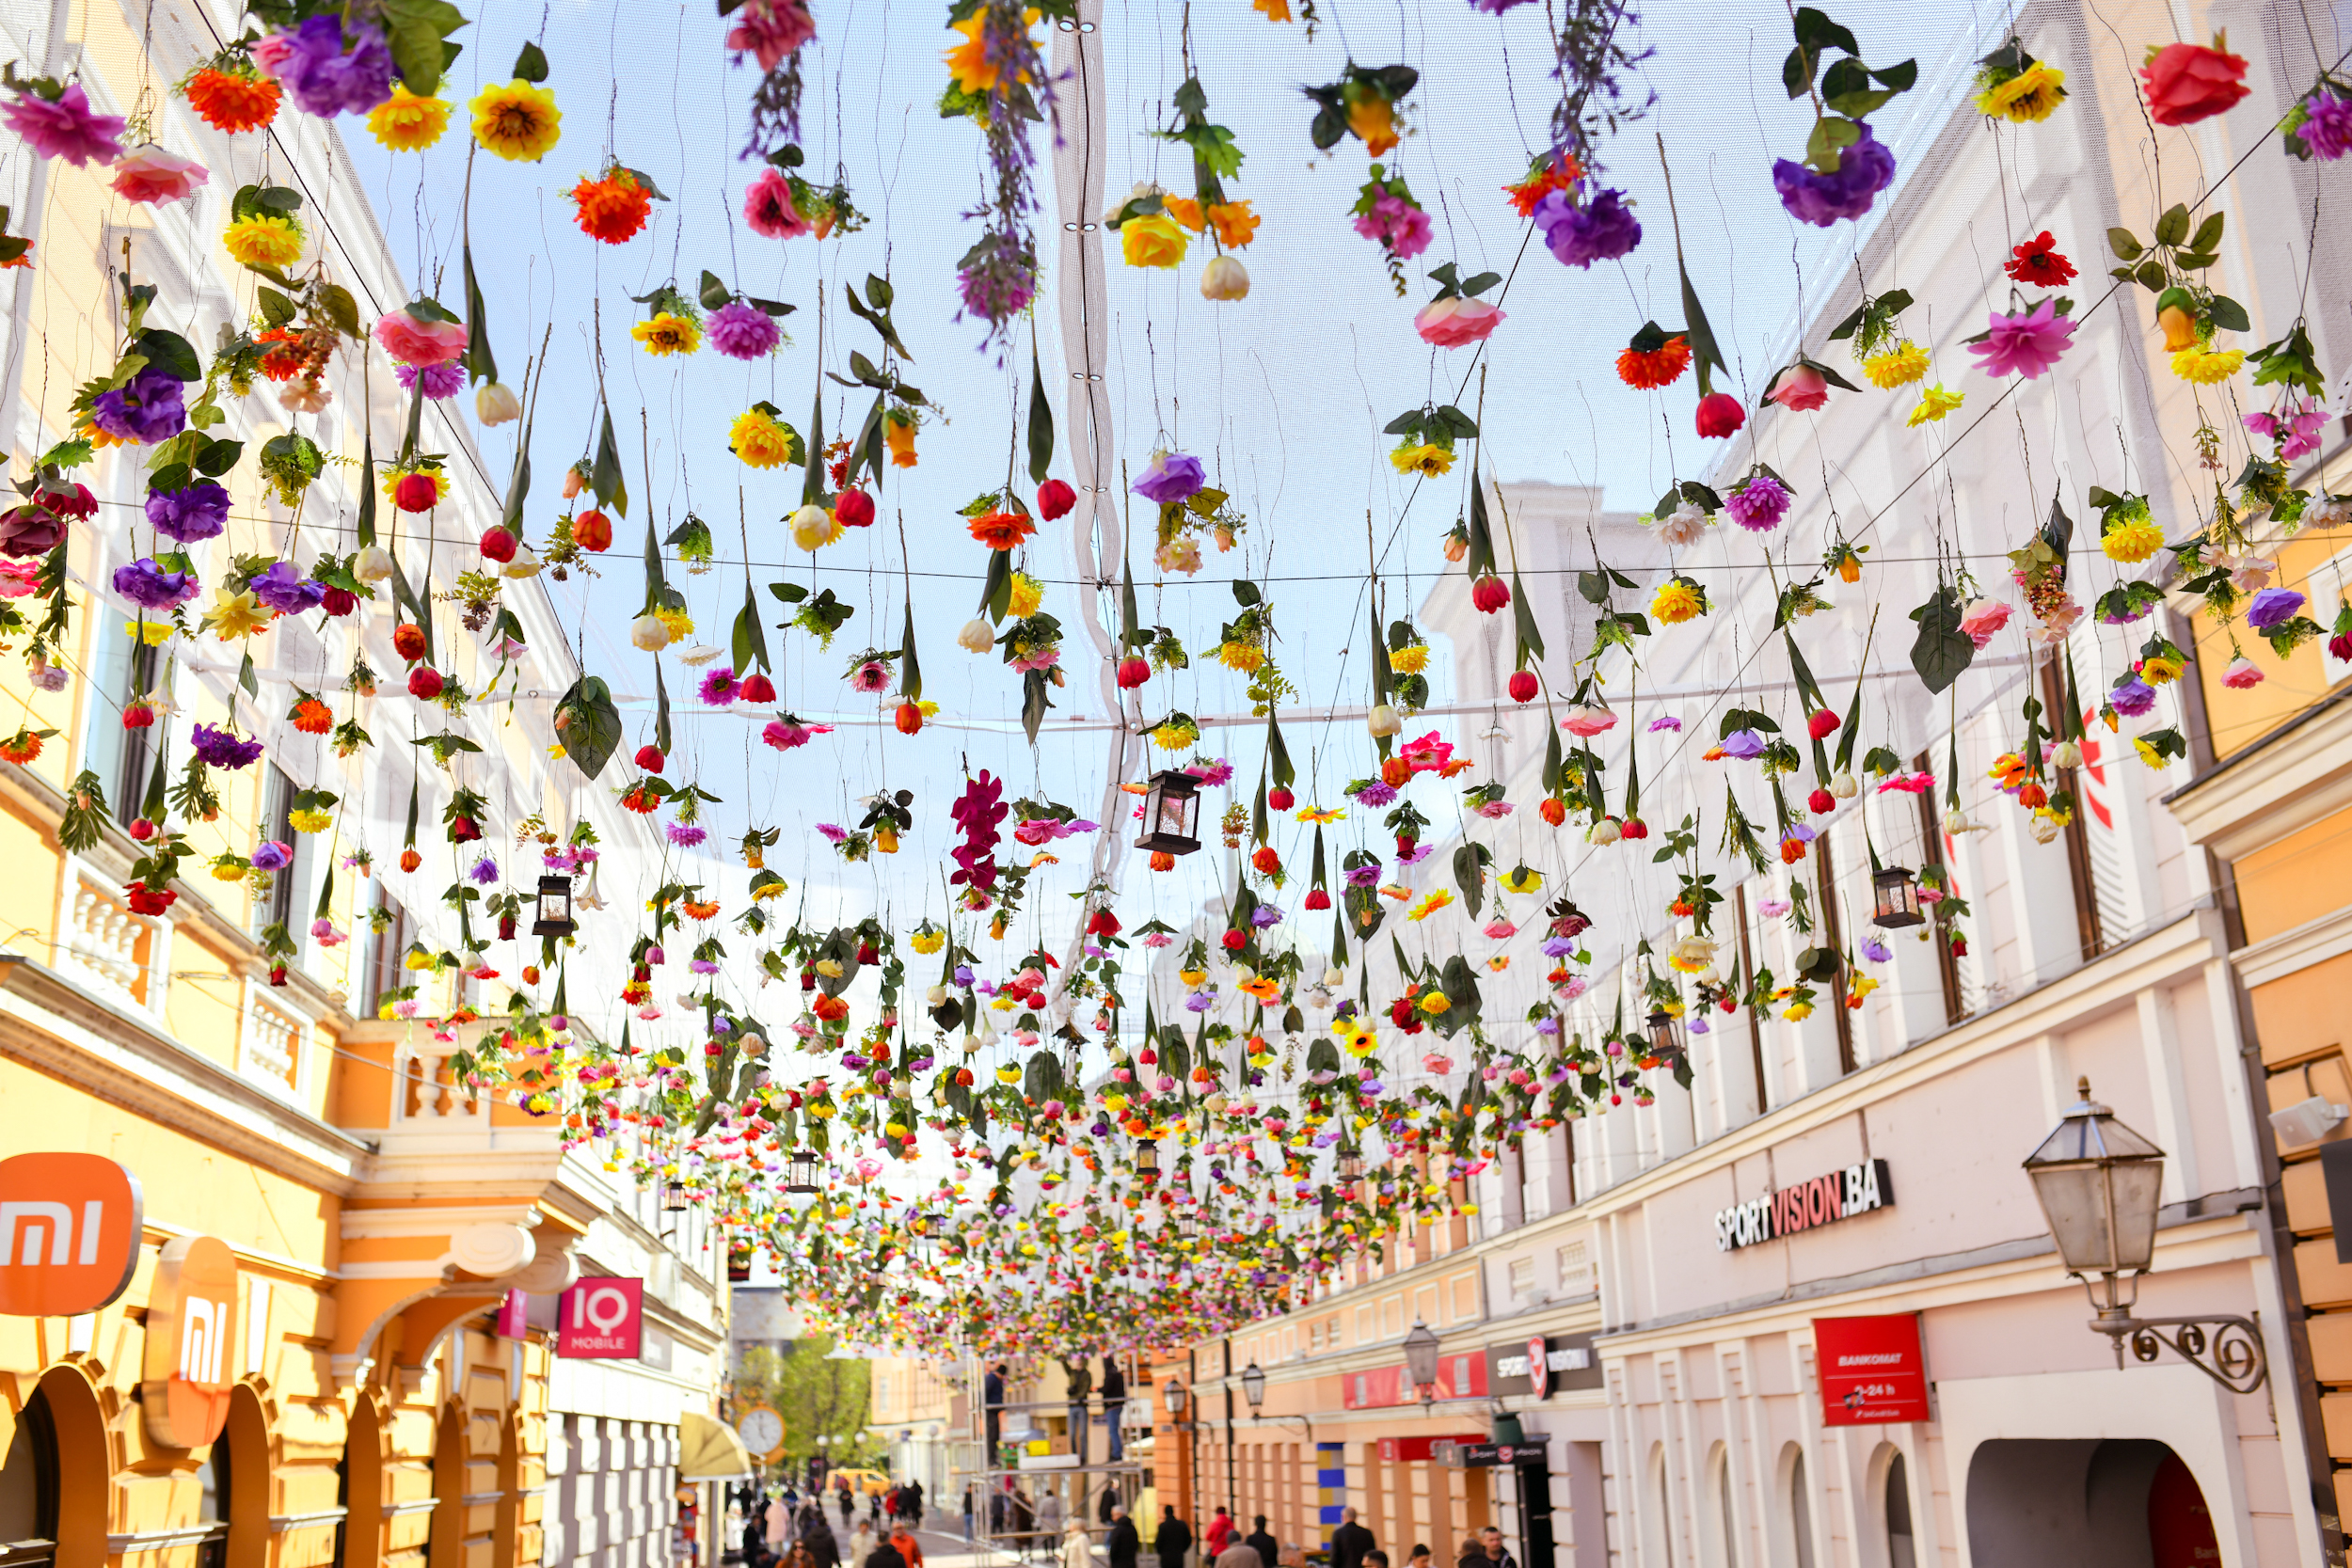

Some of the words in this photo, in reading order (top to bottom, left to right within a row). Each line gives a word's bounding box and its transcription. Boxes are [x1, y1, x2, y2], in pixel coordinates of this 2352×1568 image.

[1714, 1158, 1882, 1252] SPORTVISION.BA
[573, 1287, 628, 1337] IQ
[571, 1336, 626, 1350] MOBILE
[1838, 1353, 1903, 1367] BANKOMAT
